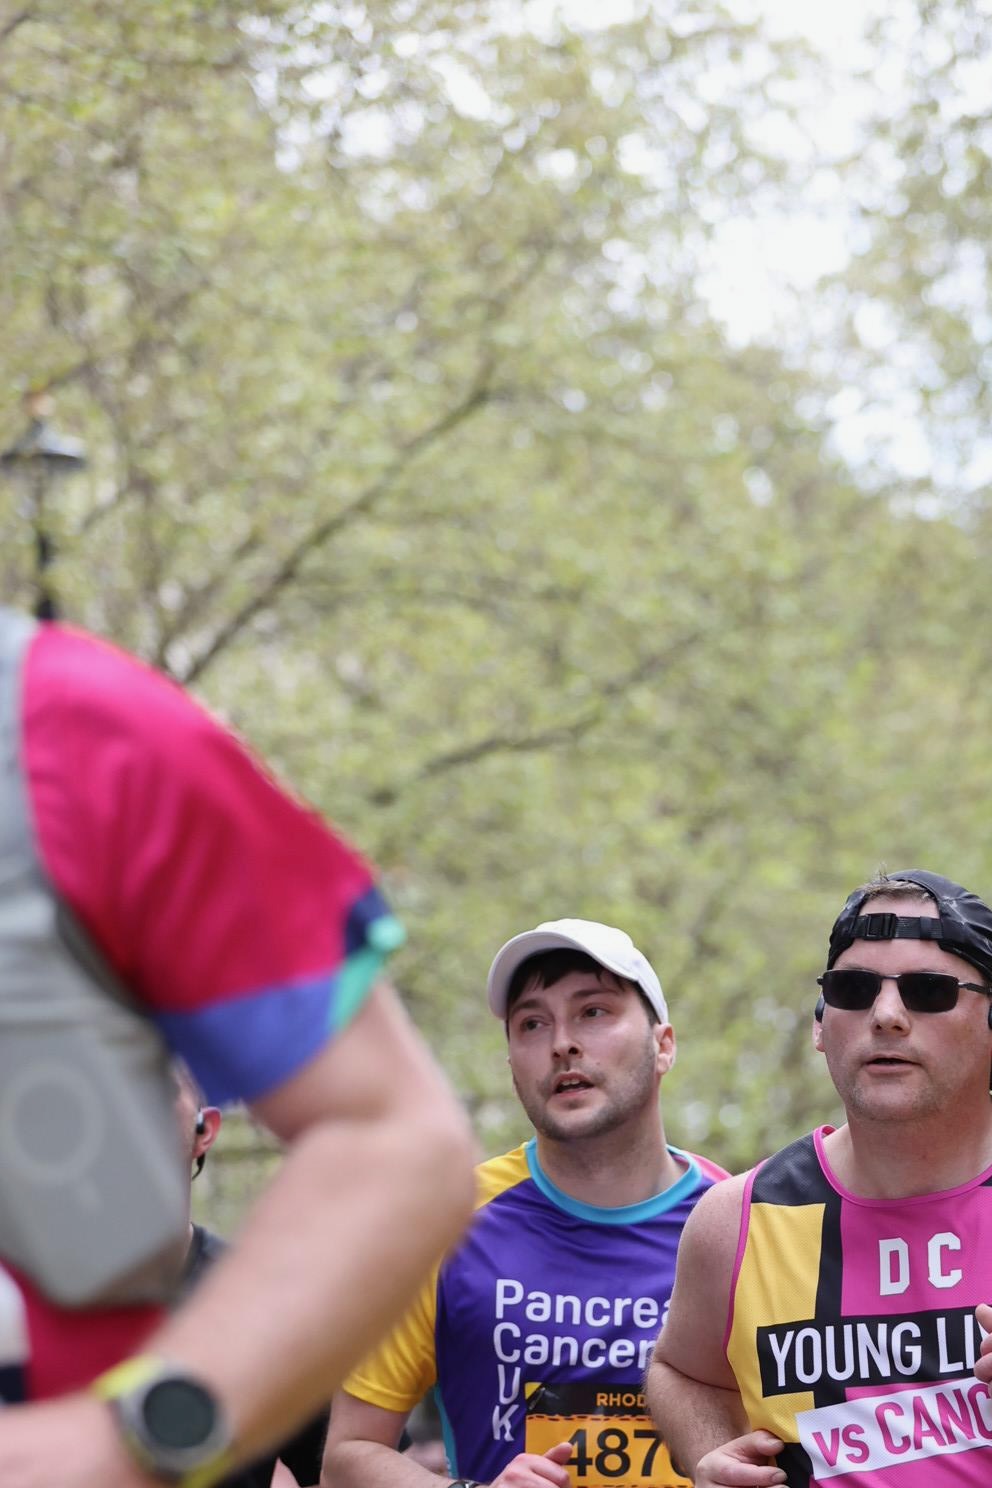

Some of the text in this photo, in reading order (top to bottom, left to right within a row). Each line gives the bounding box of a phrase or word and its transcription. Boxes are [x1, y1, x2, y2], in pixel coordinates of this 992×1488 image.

[495, 1278, 671, 1328] Pancre
[493, 1321, 657, 1370] Cancer
[767, 1321, 923, 1388] YOUNG
[595, 1392, 649, 1408] RHOD
[565, 1427, 694, 1479] 487
